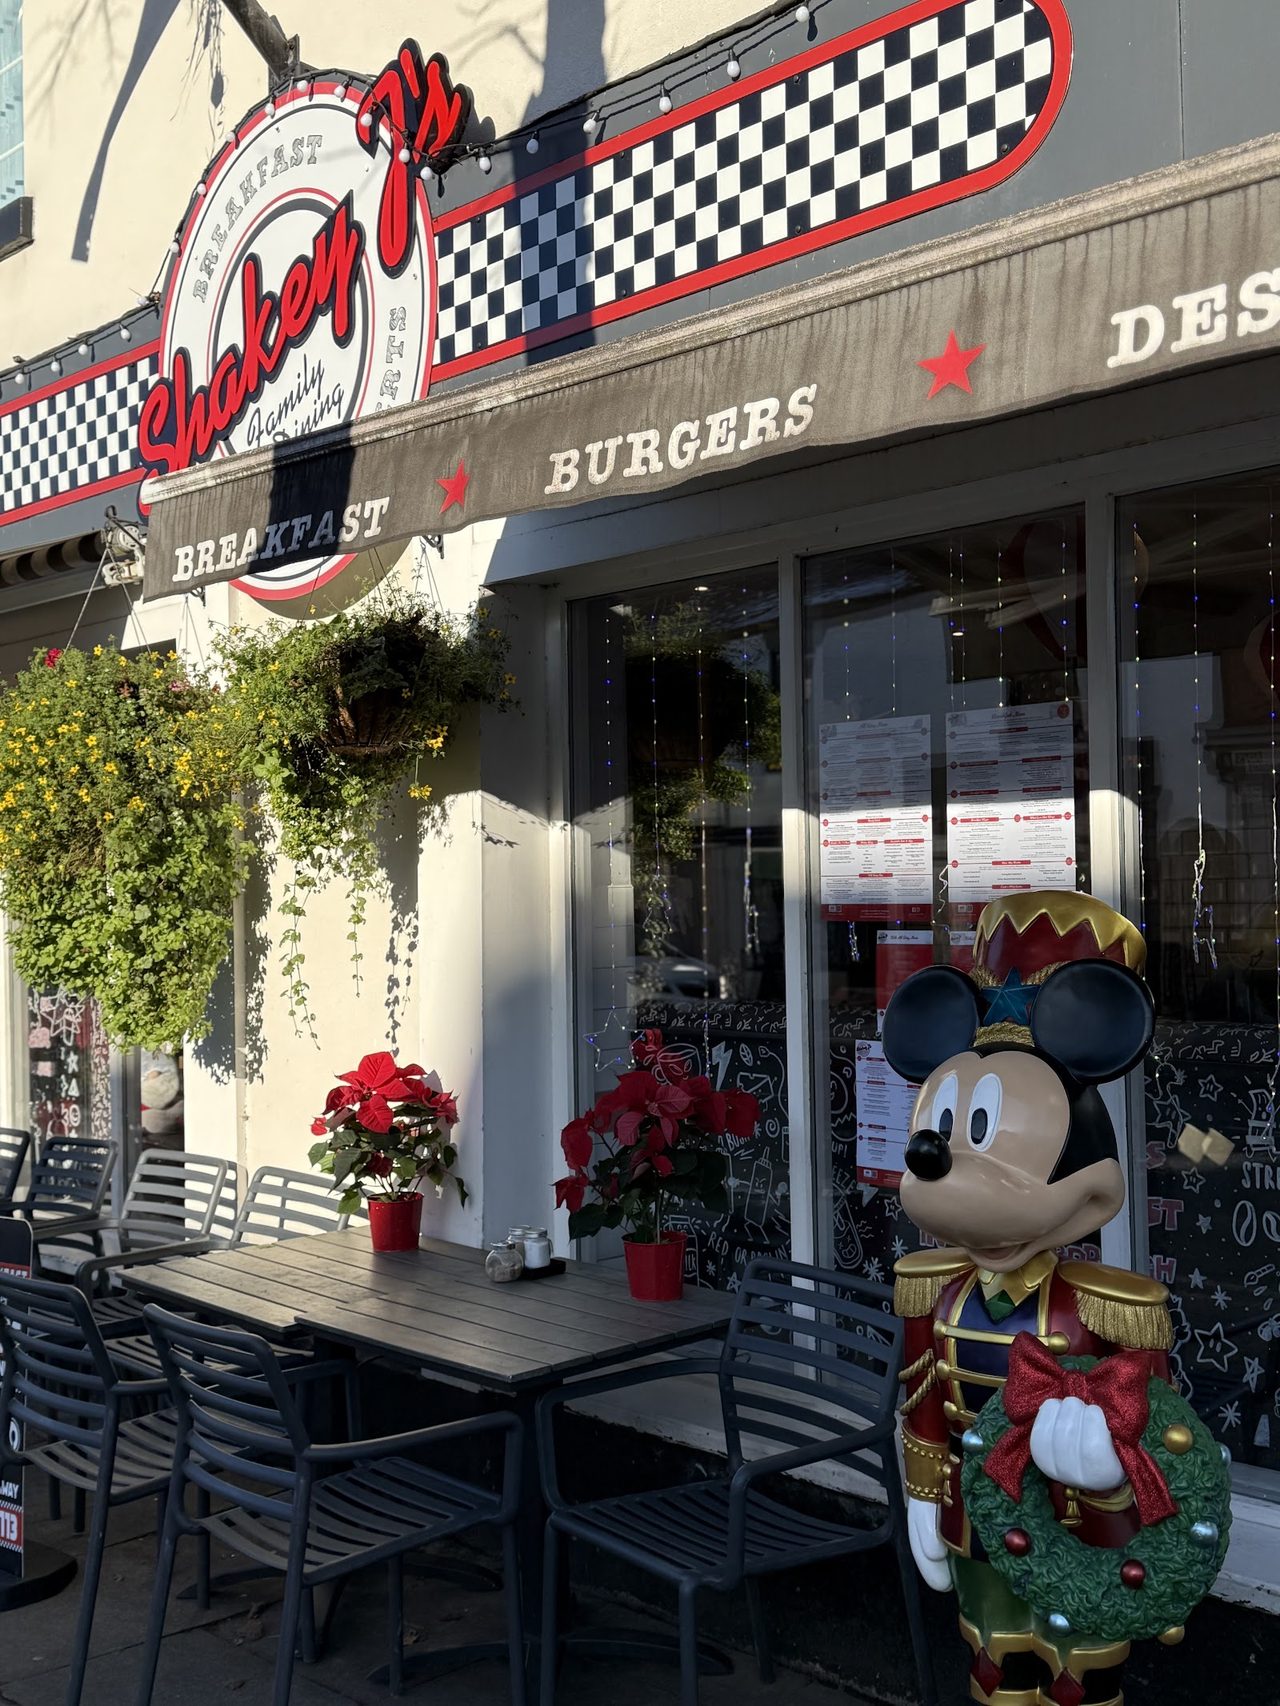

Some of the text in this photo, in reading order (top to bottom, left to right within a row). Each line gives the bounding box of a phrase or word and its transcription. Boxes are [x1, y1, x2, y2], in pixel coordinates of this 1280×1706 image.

[192, 134, 323, 303] BREAKFAST
[138, 192, 364, 514] Shakey
[1107, 268, 1280, 368] DES
[247, 353, 325, 448] Family
[544, 384, 817, 496] BURGERS
[171, 497, 390, 583] BREAKFAST
[684, 1253, 697, 1272] ILK
[707, 1231, 729, 1256] RED
